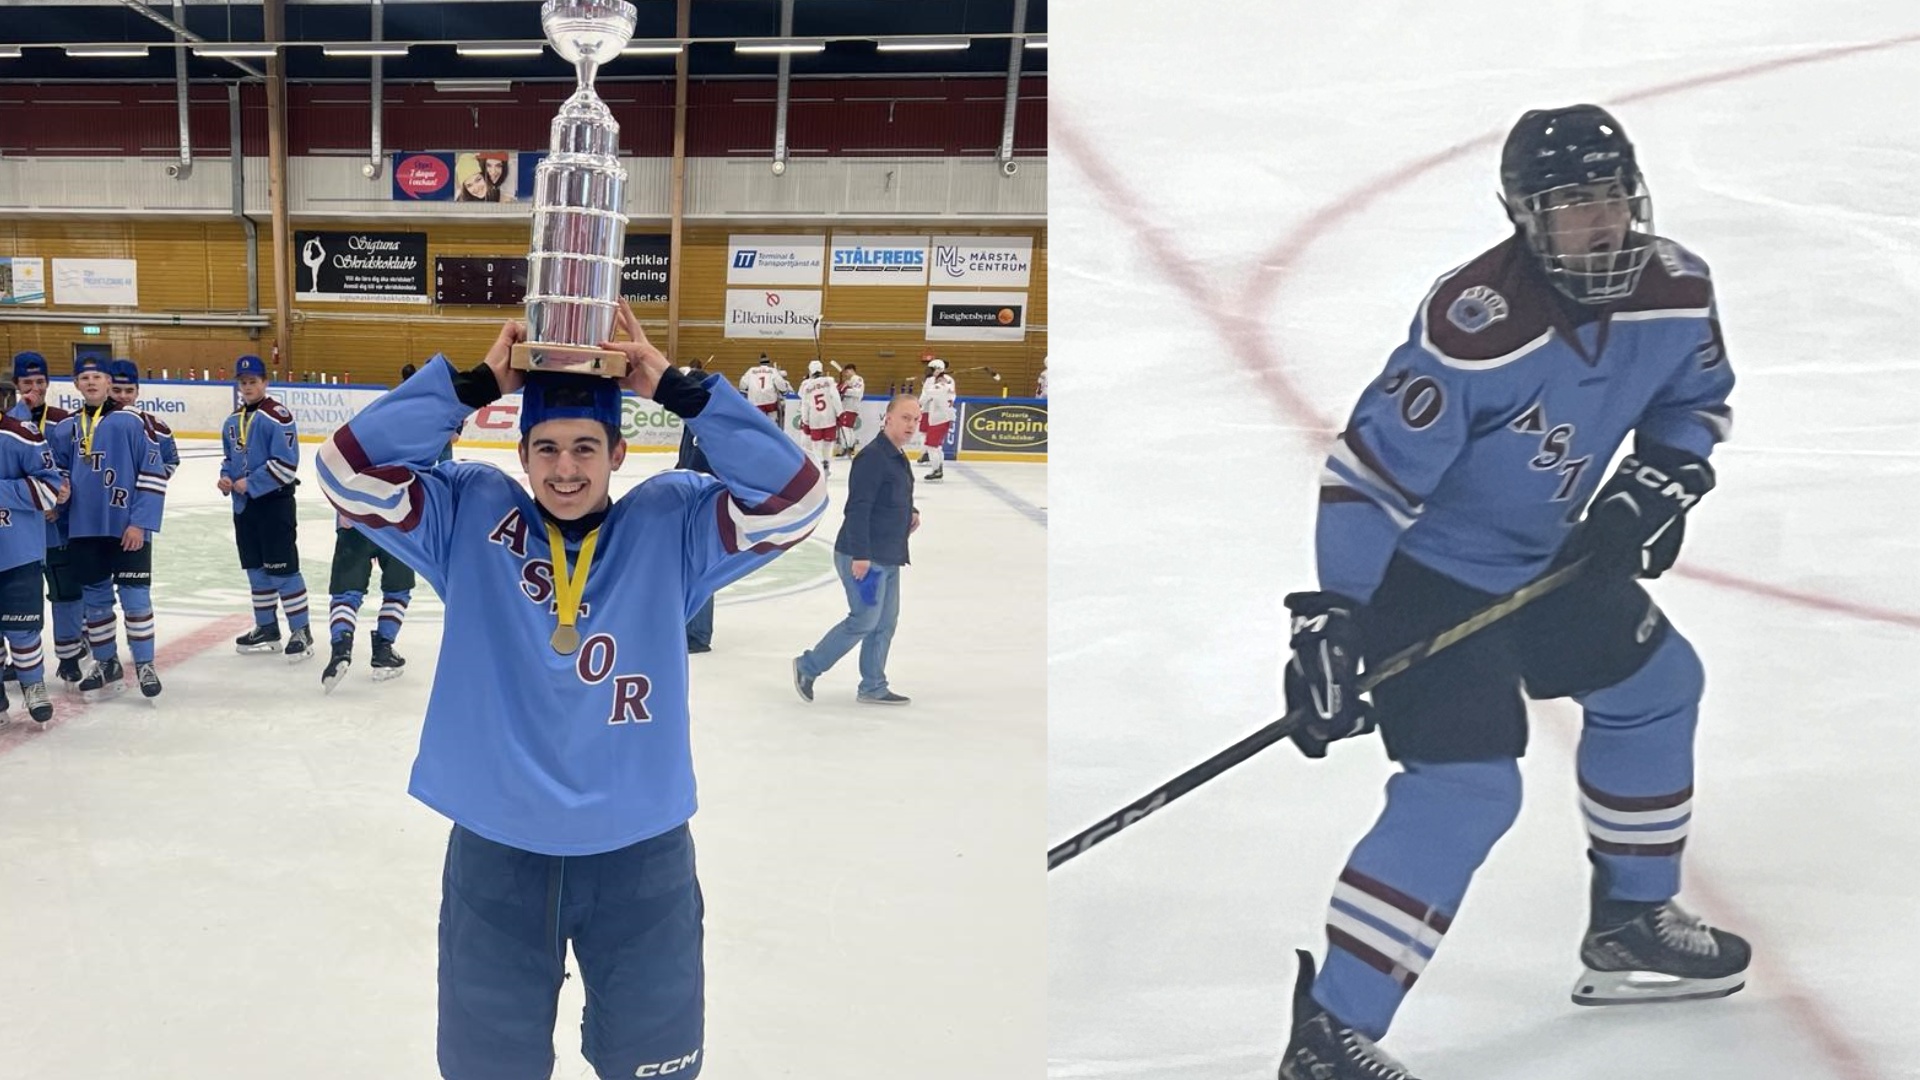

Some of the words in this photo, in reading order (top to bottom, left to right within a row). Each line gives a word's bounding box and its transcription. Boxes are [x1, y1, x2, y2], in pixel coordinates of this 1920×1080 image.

[348, 235, 401, 255] Sigtuna
[834, 247, 924, 265] STÅLFREDS
[970, 252, 1018, 262] MÄRSTA
[333, 254, 418, 270] Skridskoklubb
[437, 263, 444, 272] A
[487, 263, 494, 272] D
[969, 263, 1027, 272] CENTRUM
[437, 277, 443, 286] B
[487, 277, 493, 286] E
[437, 291, 443, 300] C
[487, 292, 493, 300] F
[939, 311, 996, 322] Fastighetsbyrån
[759, 376, 765, 389] 1
[292, 391, 345, 406] PRIMA
[814, 393, 826, 411] 5
[284, 432, 296, 449] 7
[2, 614, 40, 622] BAUER
[634, 1048, 700, 1078] CCM
